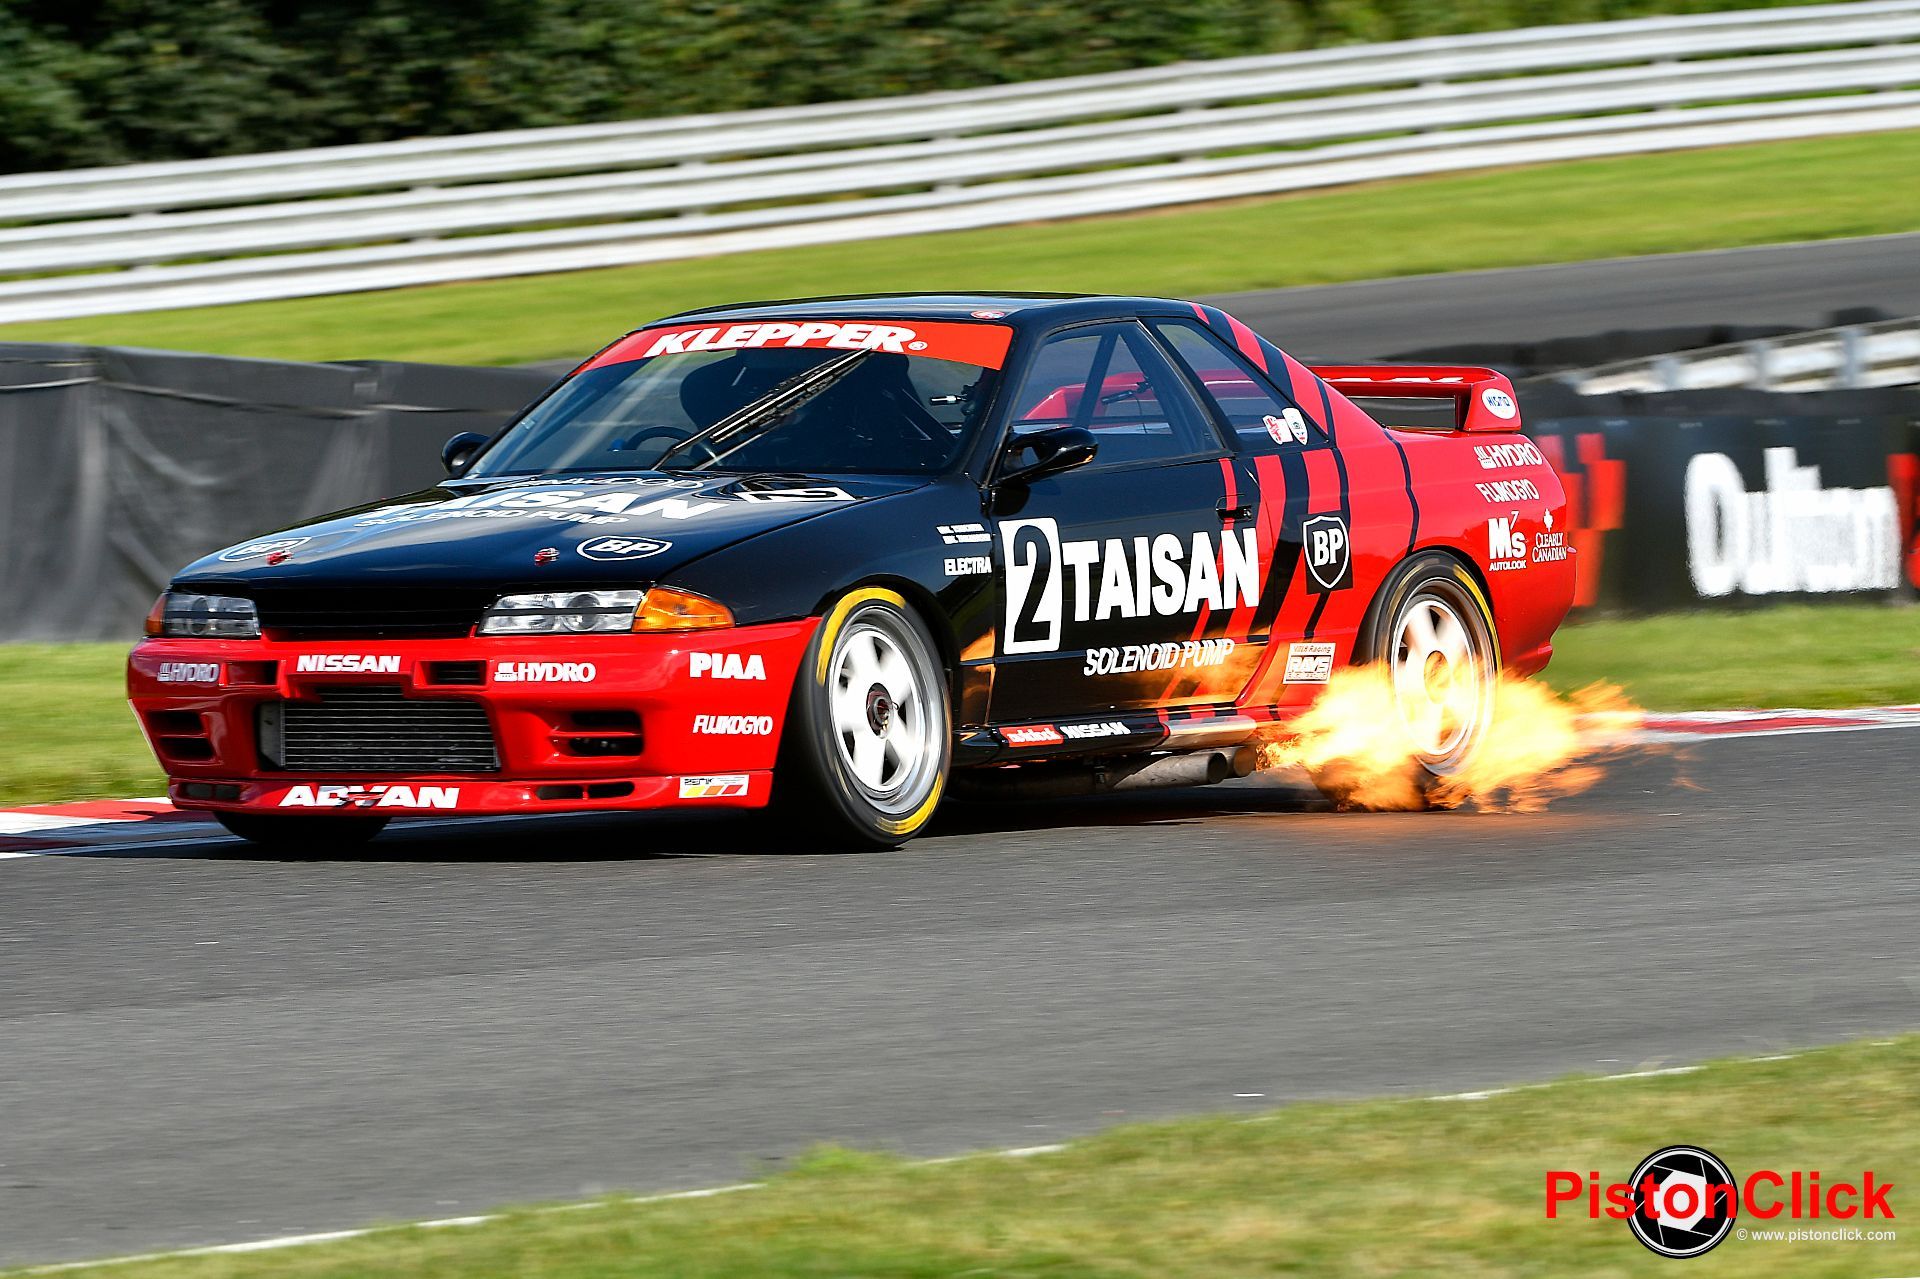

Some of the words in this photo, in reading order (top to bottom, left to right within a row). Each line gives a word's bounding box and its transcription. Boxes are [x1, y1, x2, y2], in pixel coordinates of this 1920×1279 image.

[644, 322, 917, 354] KLEPPER
[1490, 442, 1543, 468] HYDRO
[585, 539, 659, 554] BP
[1312, 527, 1345, 567] BP
[1535, 532, 1563, 548] CLEARLY
[1532, 546, 1567, 563] CANADIAN
[944, 556, 992, 576] ELECTRA
[1489, 560, 1527, 571] AUTOLOOK
[1014, 524, 1052, 642] 2
[1062, 528, 1260, 622] TAISAN
[296, 655, 401, 672] NISSAN
[689, 652, 767, 681] PIAA
[1083, 642, 1181, 677] SOLENOID
[1179, 638, 1236, 668] PUMP
[170, 663, 220, 683] HYDRO
[518, 662, 596, 682] HYDRO
[1060, 721, 1132, 739] NISSAN
[279, 785, 460, 809] ADVAN
